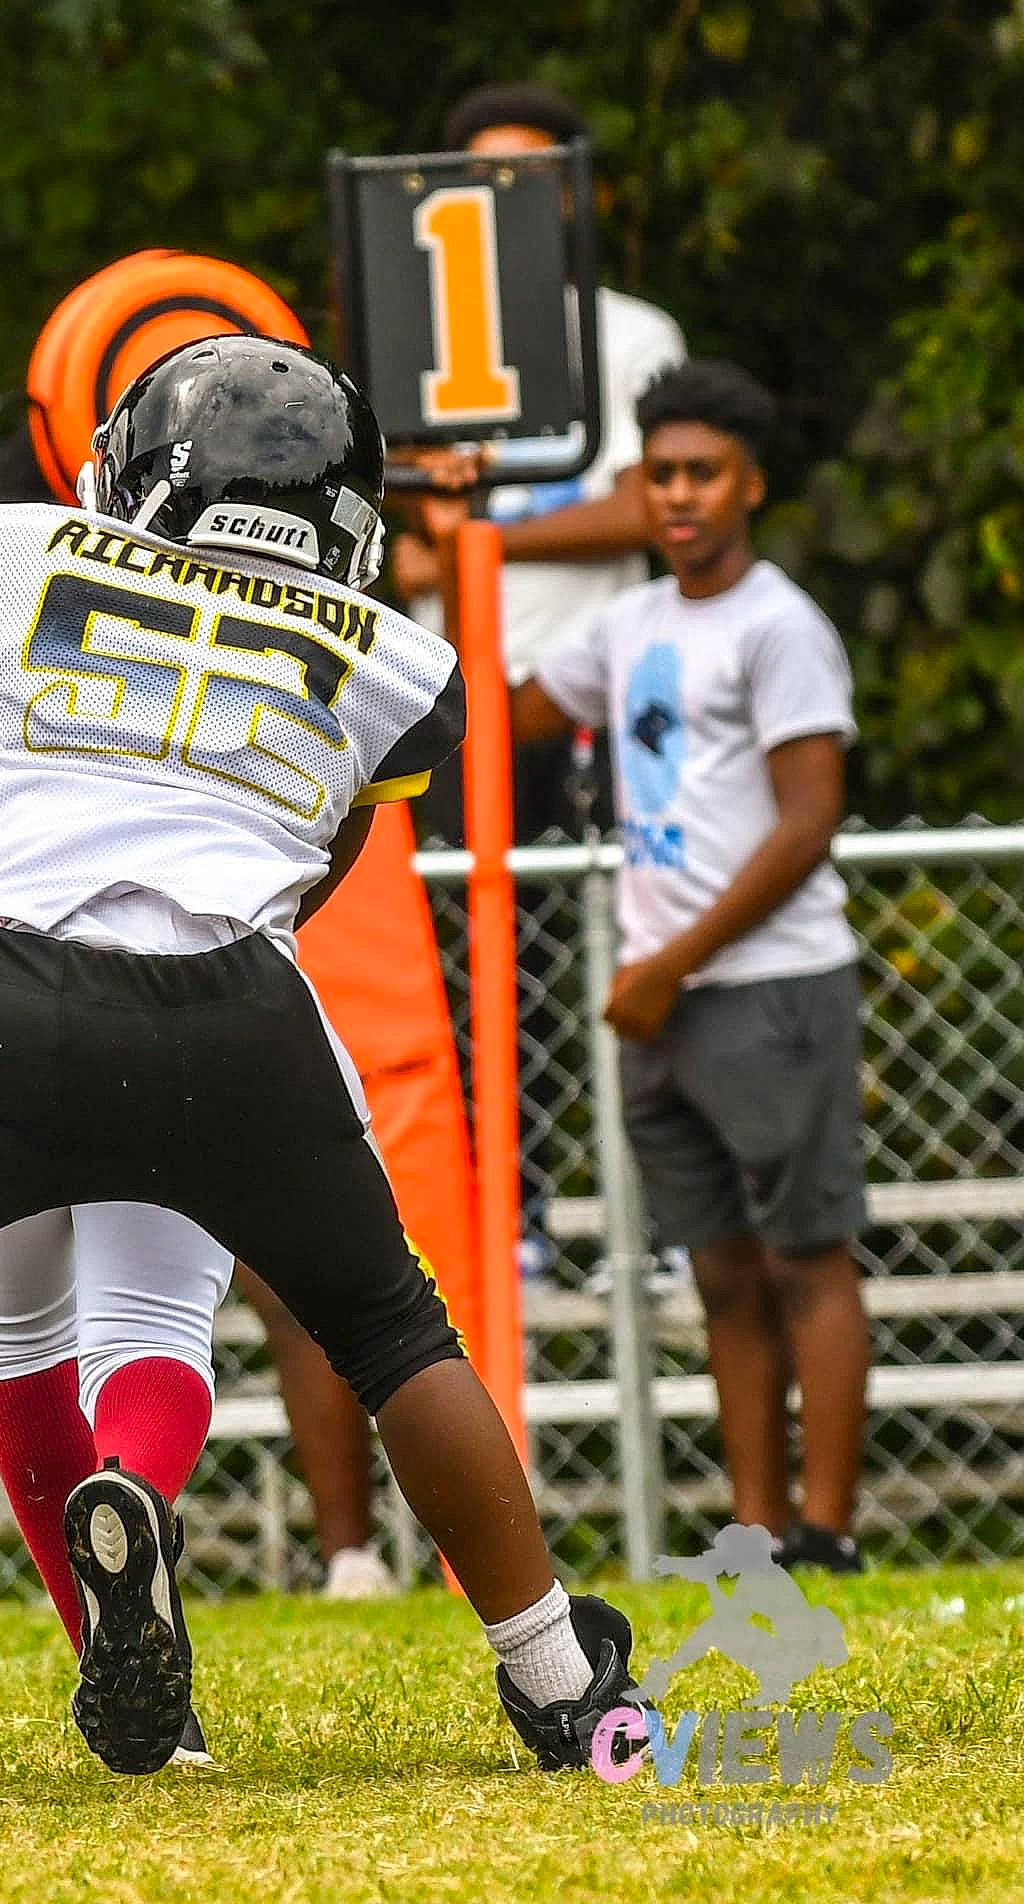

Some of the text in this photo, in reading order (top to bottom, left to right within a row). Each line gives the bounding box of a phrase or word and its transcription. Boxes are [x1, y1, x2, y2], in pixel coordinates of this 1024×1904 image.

[413, 184, 523, 427] 1
[45, 517, 379, 657] RICHARDSON
[210, 513, 309, 549] schutt
[20, 570, 354, 822] 52
